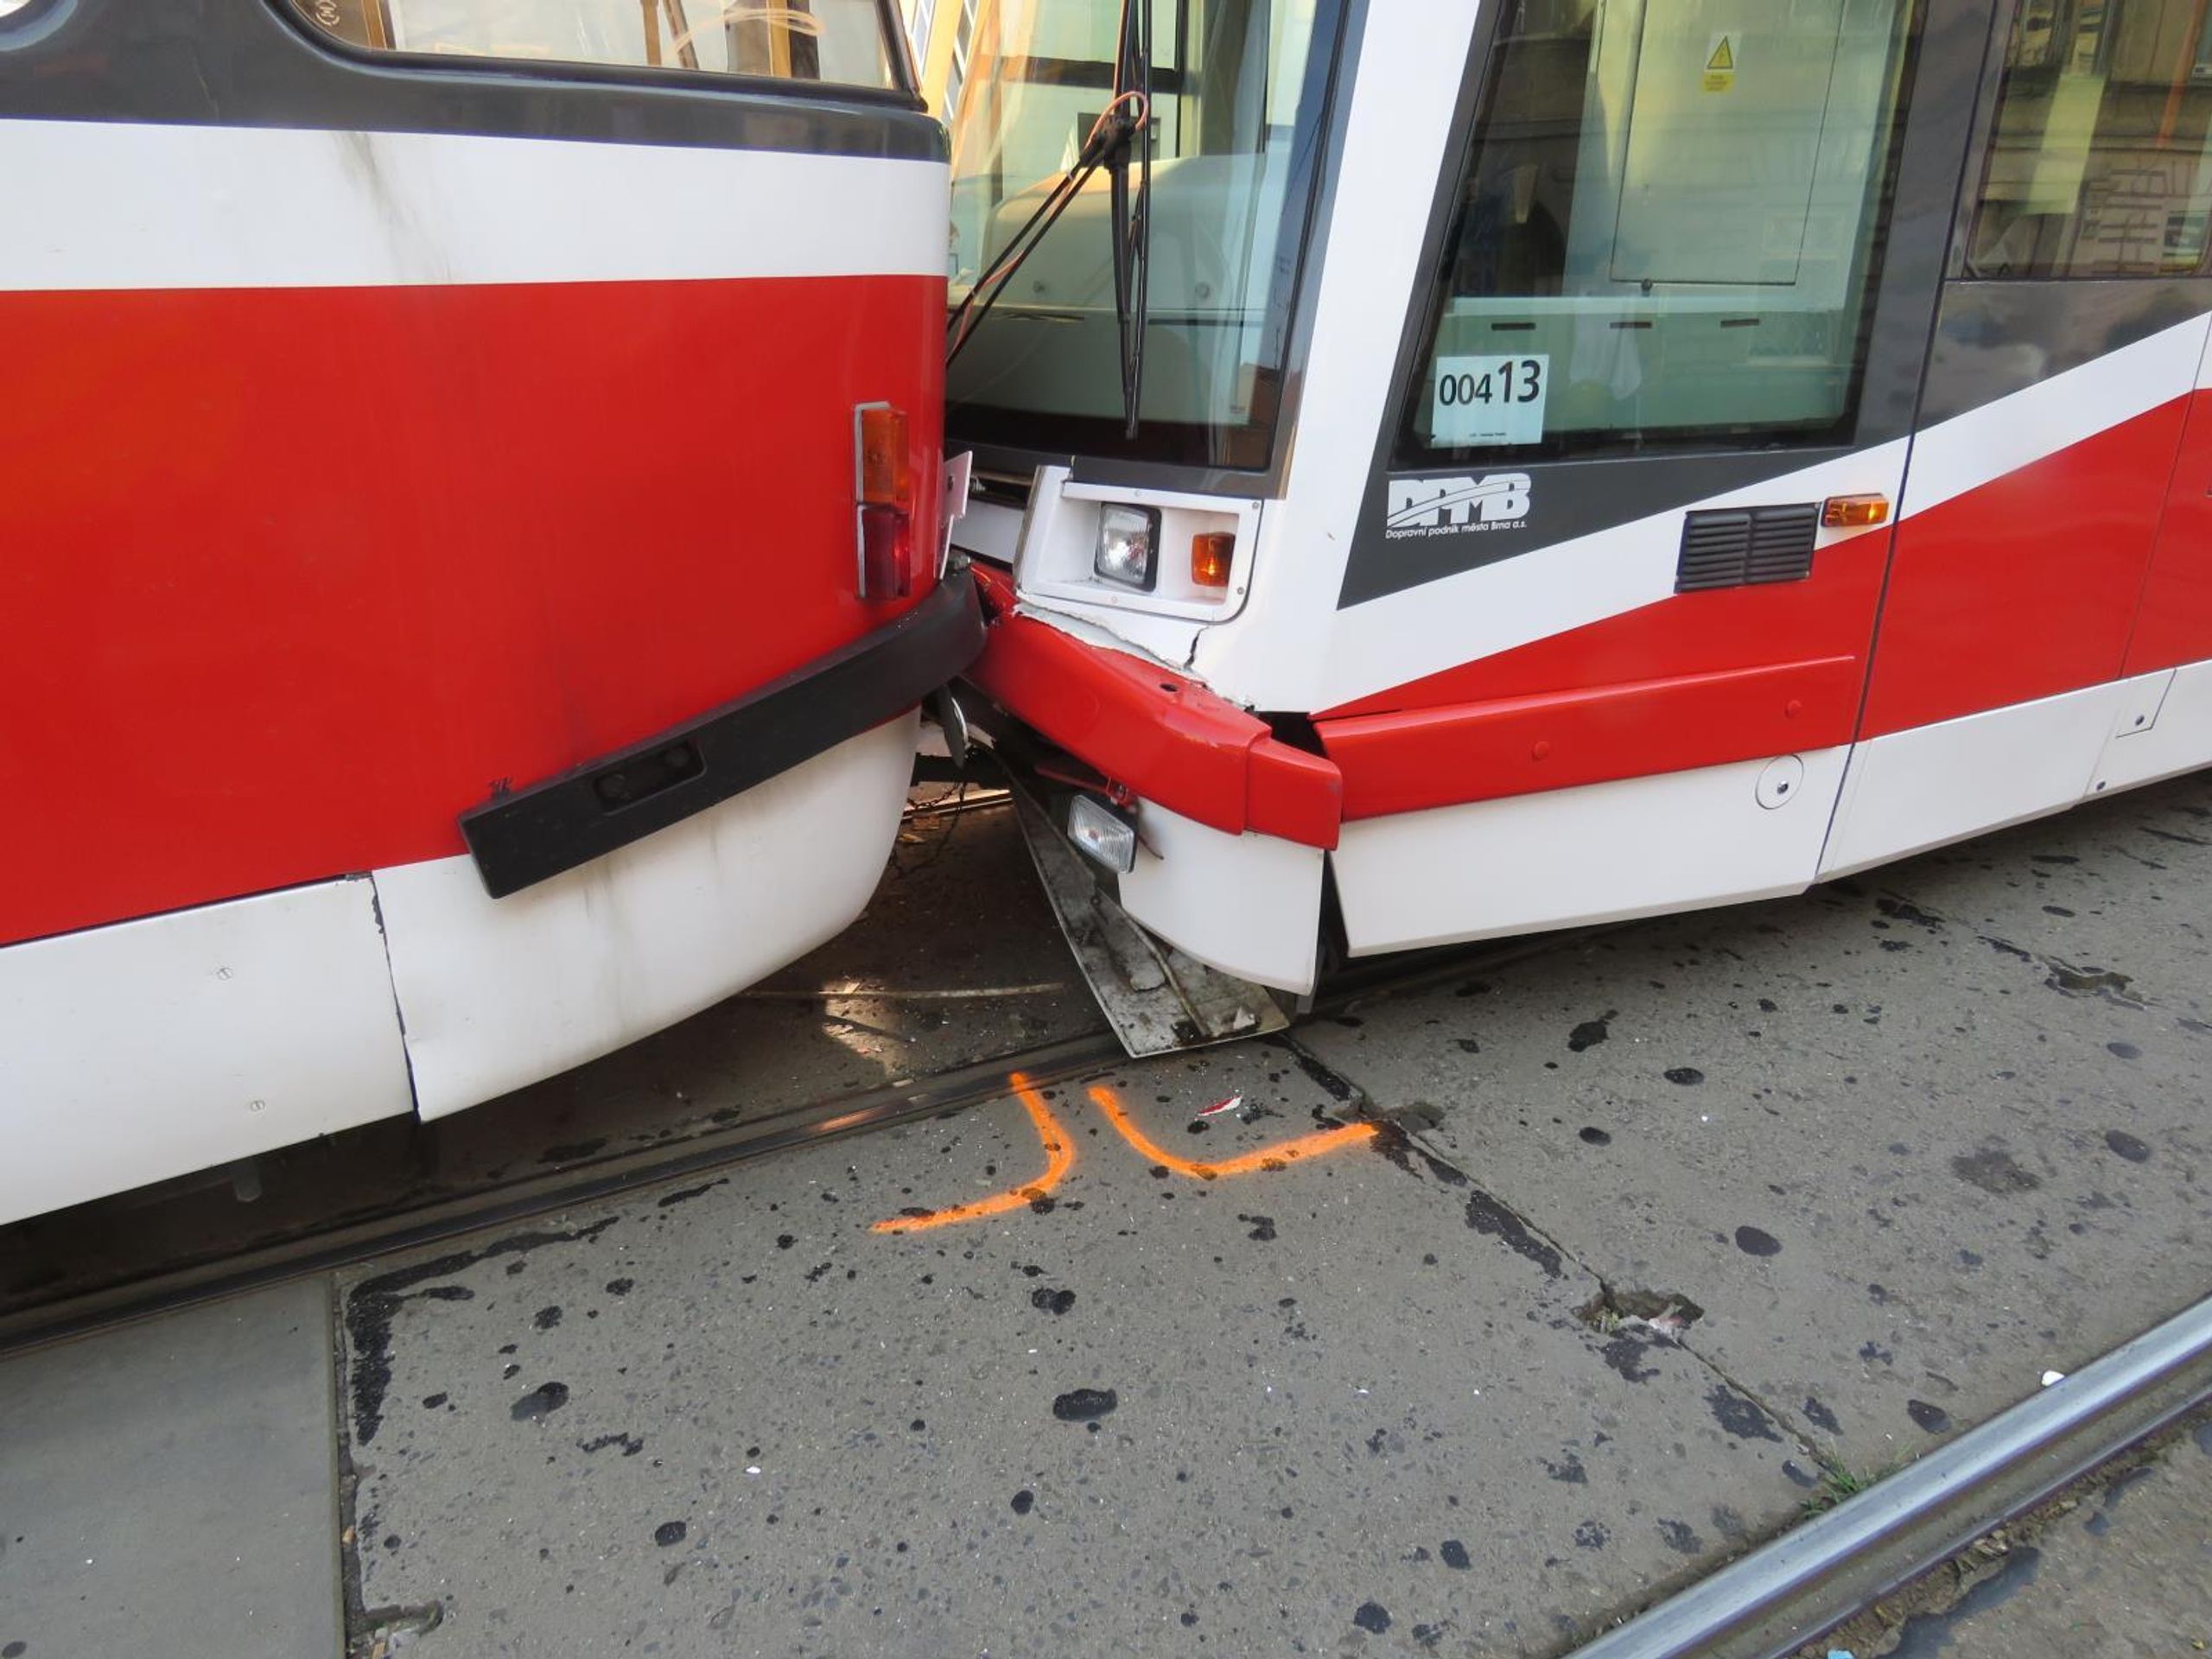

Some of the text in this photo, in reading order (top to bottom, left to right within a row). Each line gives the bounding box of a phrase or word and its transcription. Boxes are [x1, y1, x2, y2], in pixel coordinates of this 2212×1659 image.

[1385, 527, 1426, 540] Dopravní
[1428, 526, 1459, 537] podnik
[1461, 524, 1489, 532] města
[1513, 520, 1528, 529] a.s.
